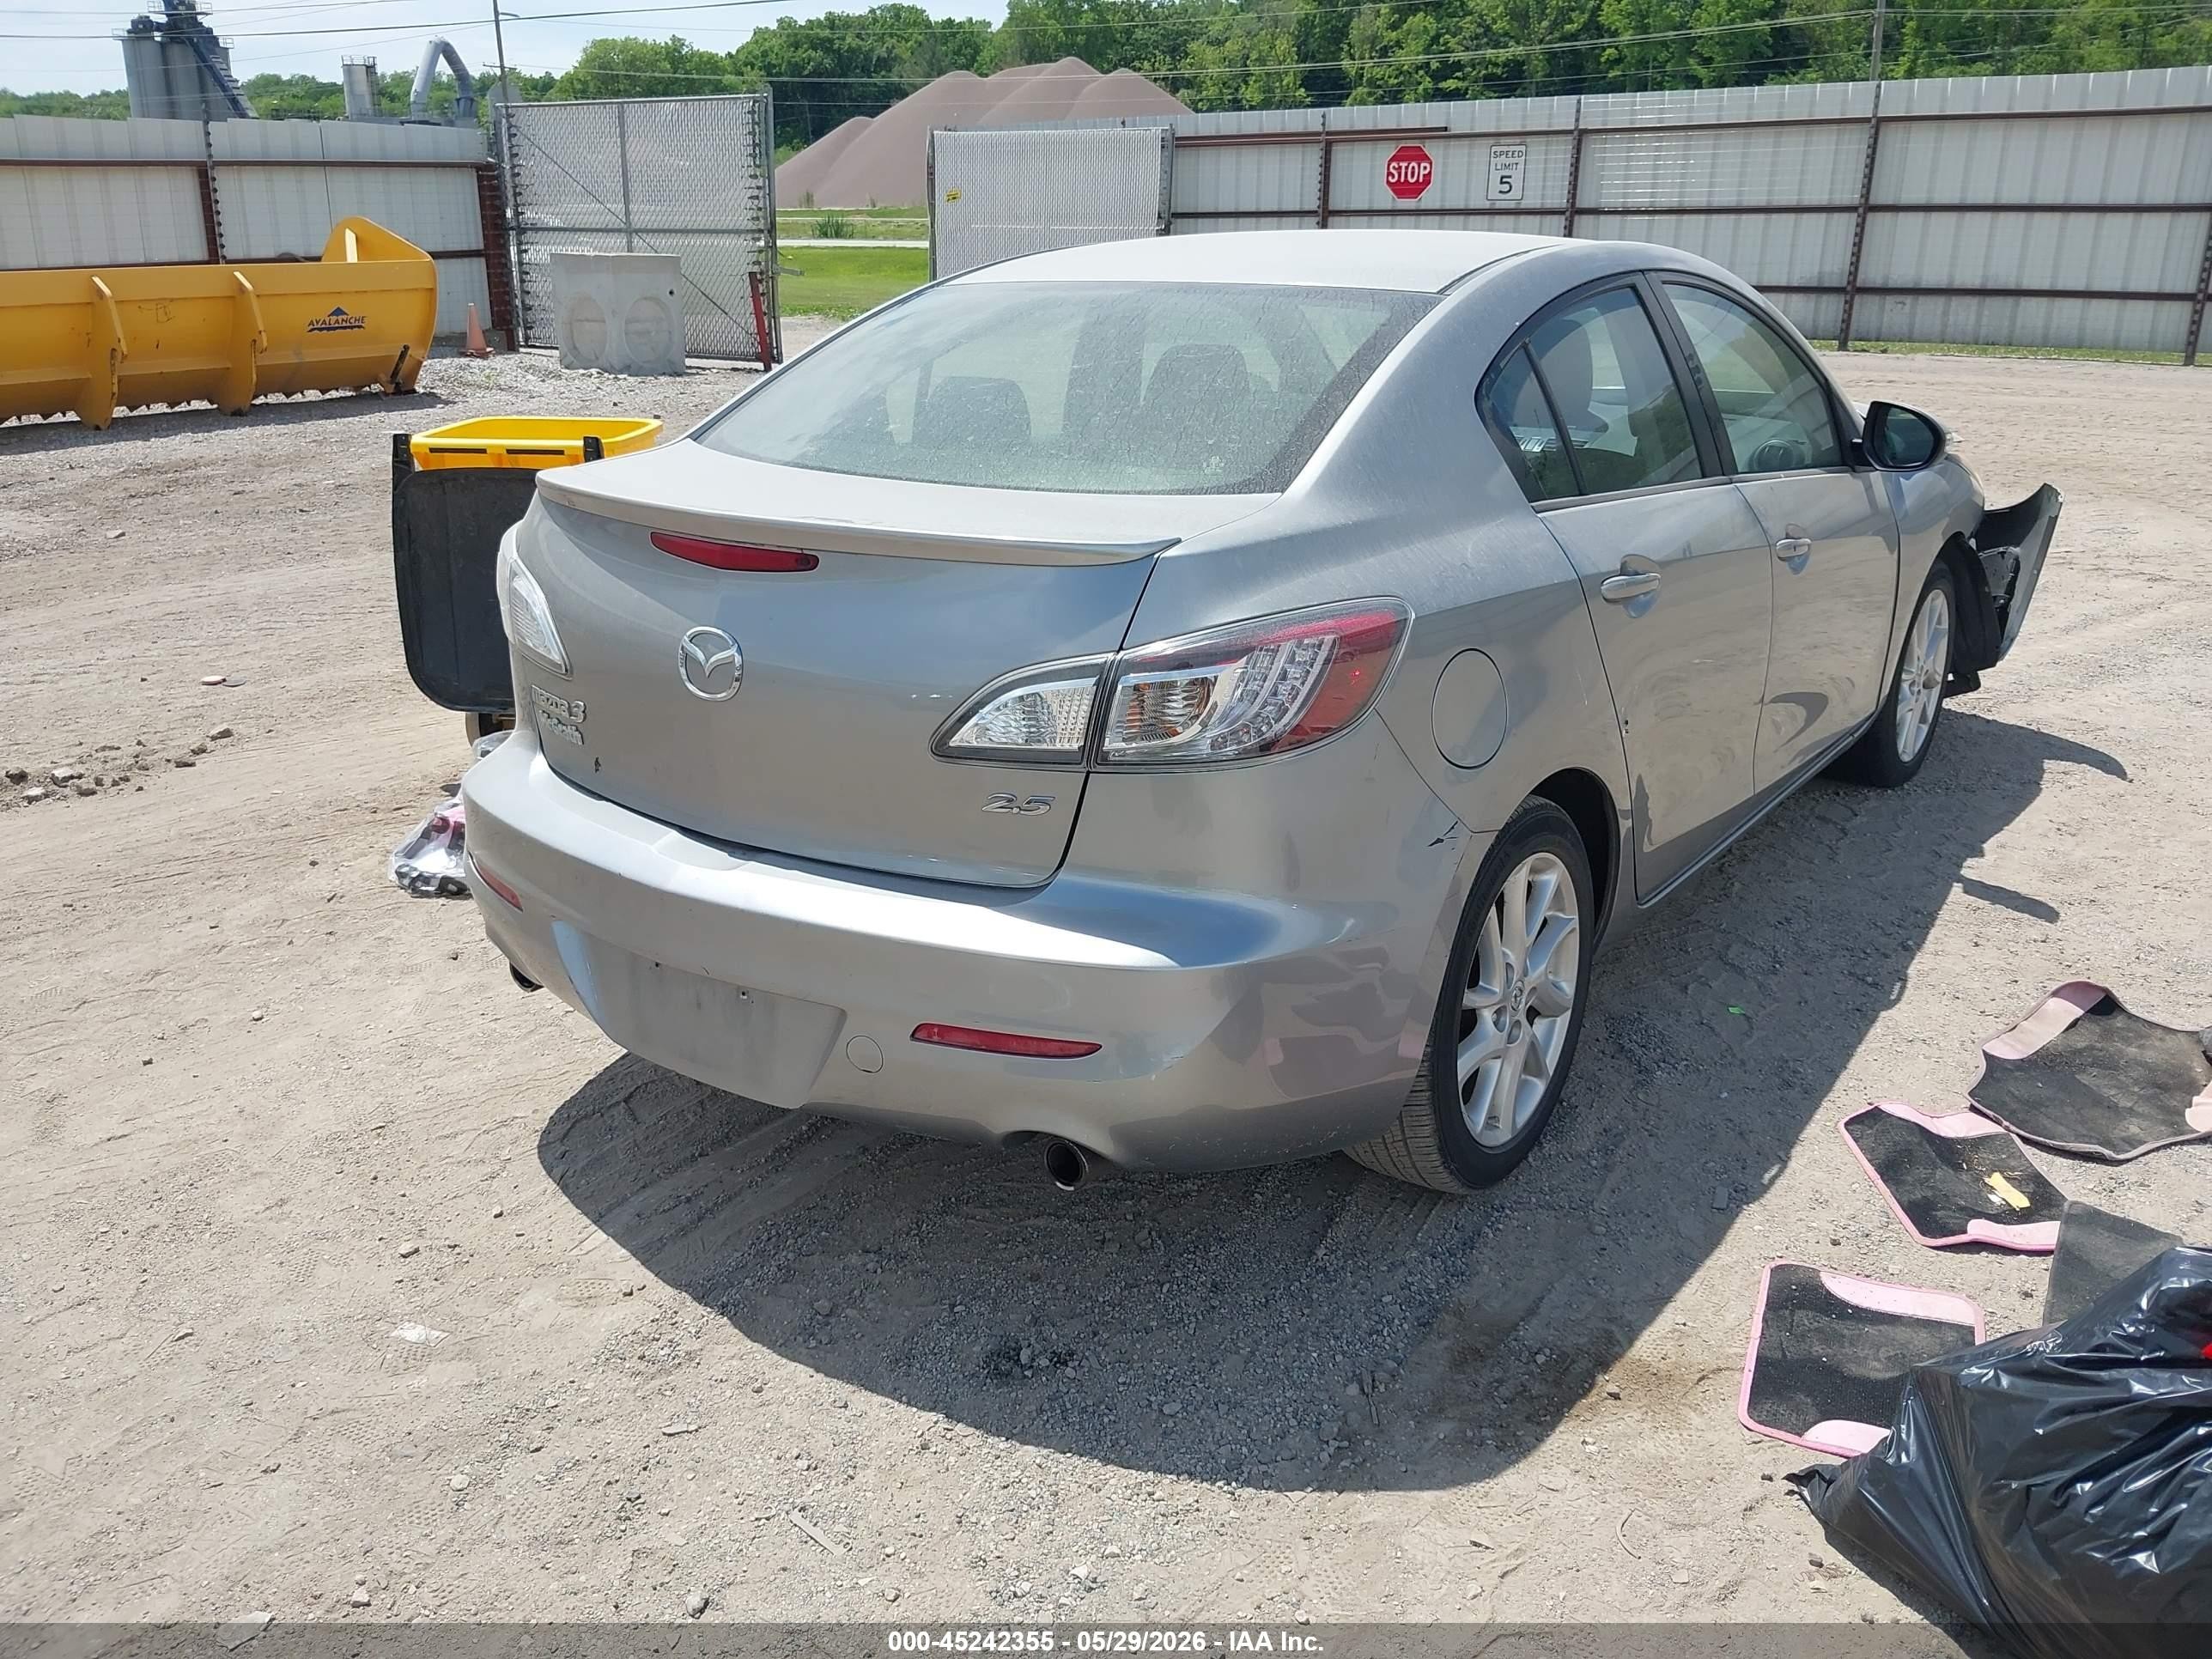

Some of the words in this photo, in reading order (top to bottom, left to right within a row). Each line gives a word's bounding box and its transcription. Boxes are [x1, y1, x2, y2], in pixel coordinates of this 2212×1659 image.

[1492, 150, 1524, 159] SPEED
[1388, 162, 1431, 184] STOP
[1494, 162, 1519, 171] LIMIT
[1498, 174, 1513, 194] 5
[307, 315, 367, 327] AVALANCHE
[981, 793, 1055, 816] 2.5
